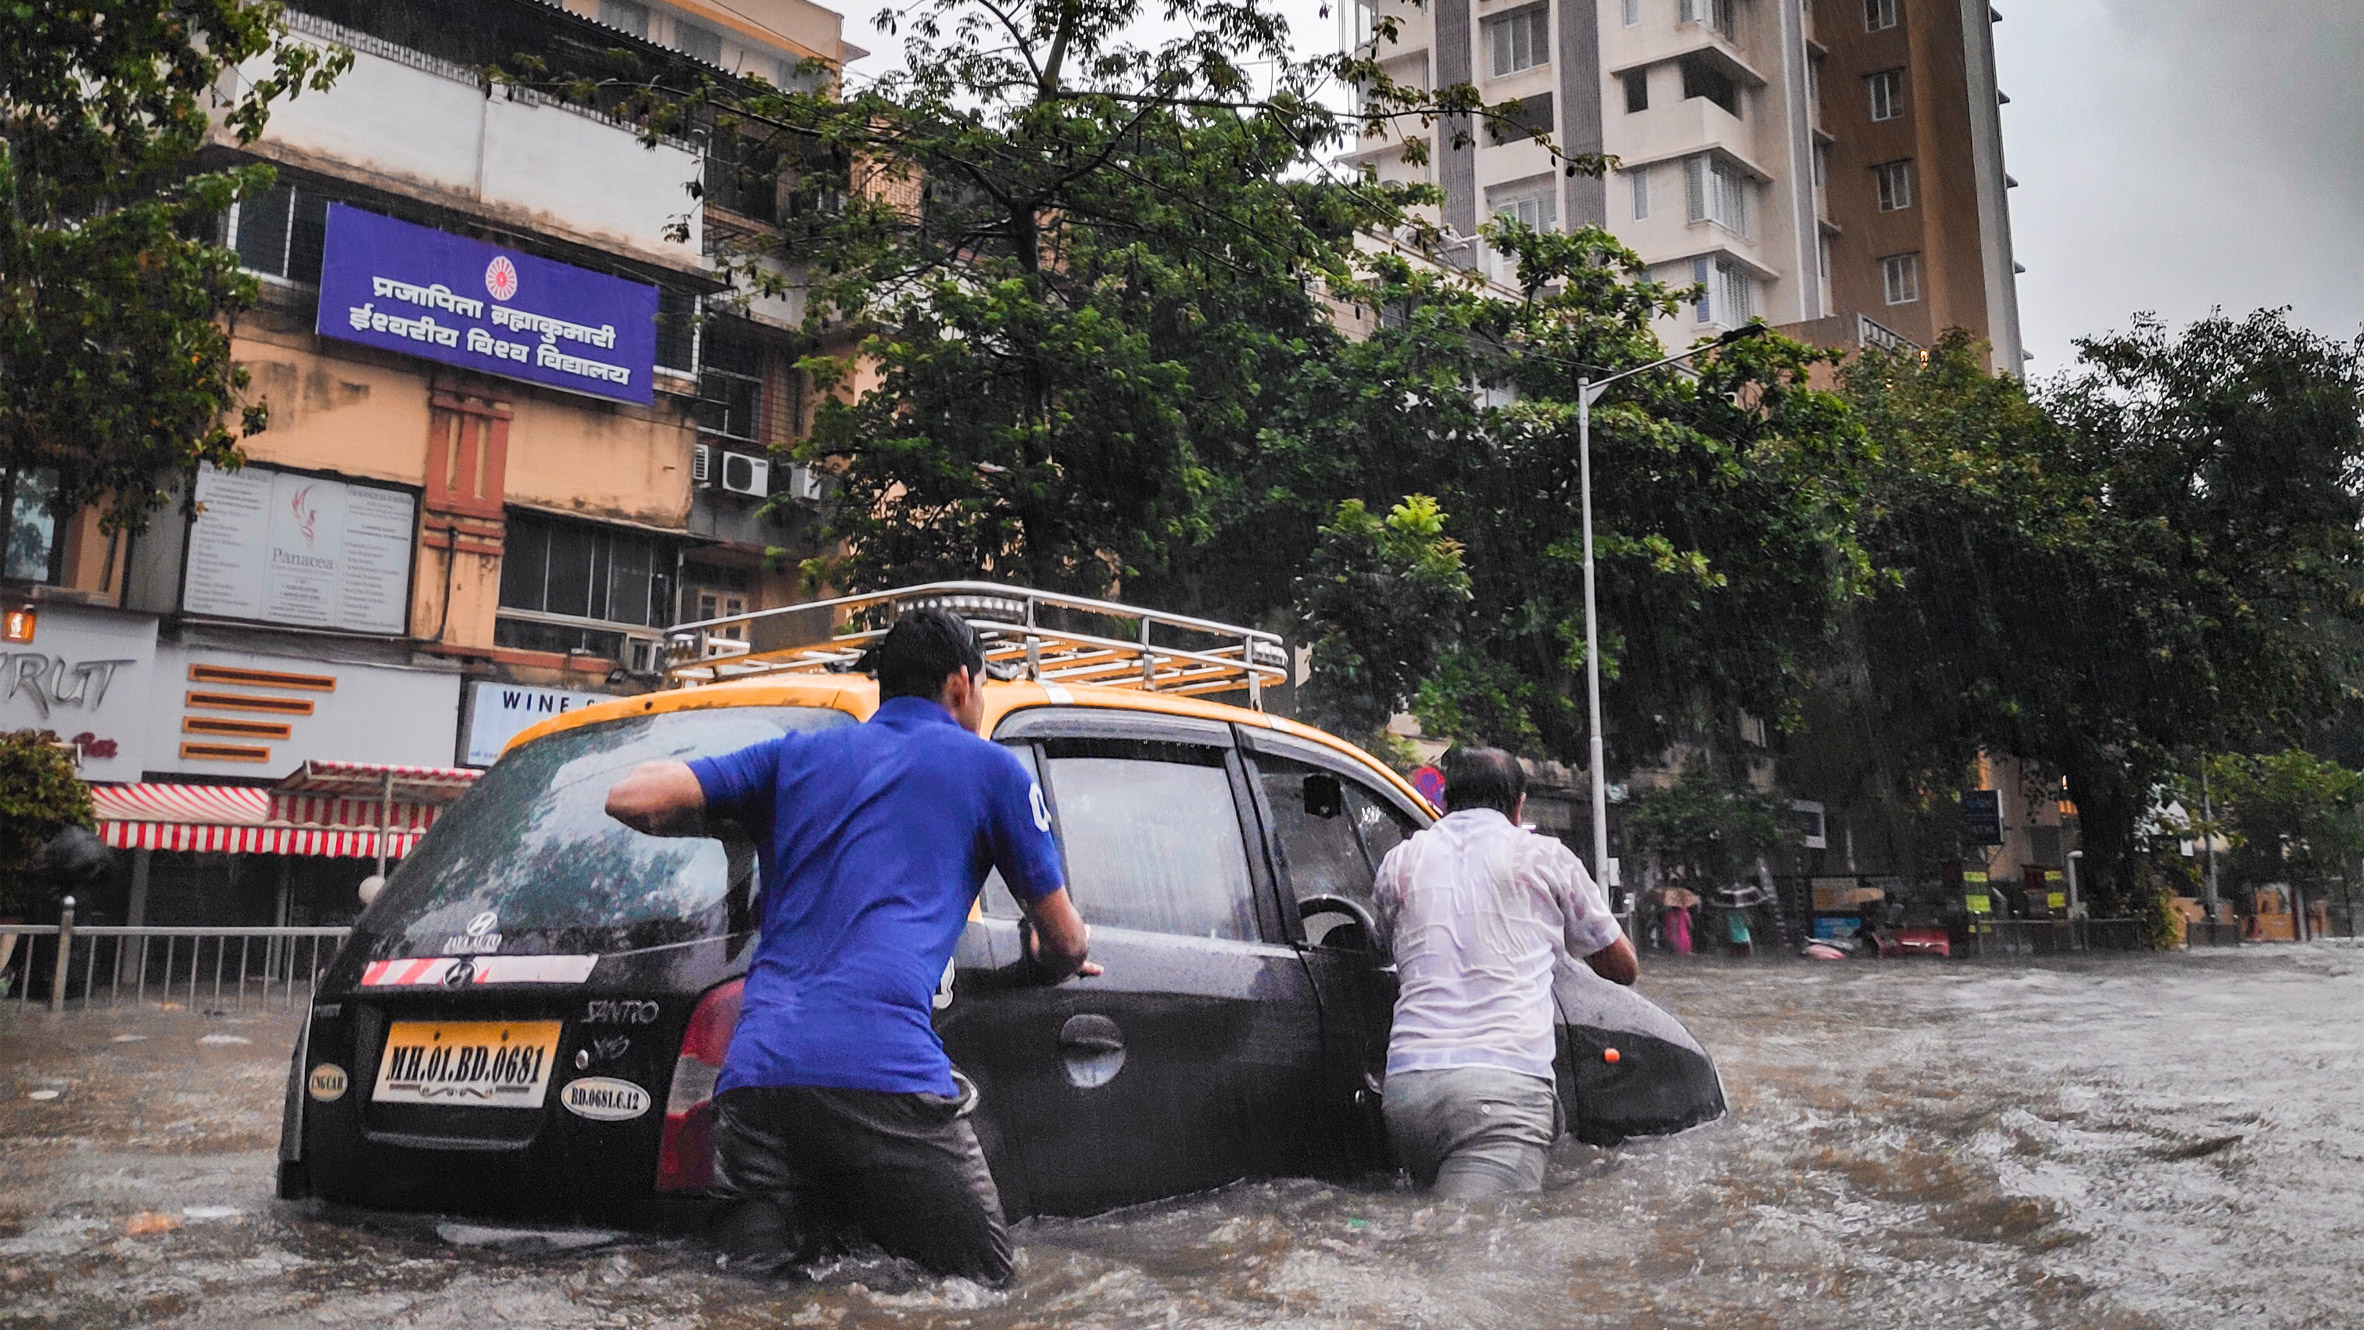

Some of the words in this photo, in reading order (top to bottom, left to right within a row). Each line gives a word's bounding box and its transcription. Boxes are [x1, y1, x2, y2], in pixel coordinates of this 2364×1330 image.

[372, 276, 483, 319] प्रजापिता
[349, 303, 459, 348] ईश्वरीय
[467, 327, 529, 363] विश्व
[536, 345, 631, 385] विद्यालय
[272, 547, 334, 570] Panacea
[503, 690, 570, 713] WINE
[580, 999, 660, 1024] SANTRO
[385, 1044, 545, 1084] MH.01.BD.0681
